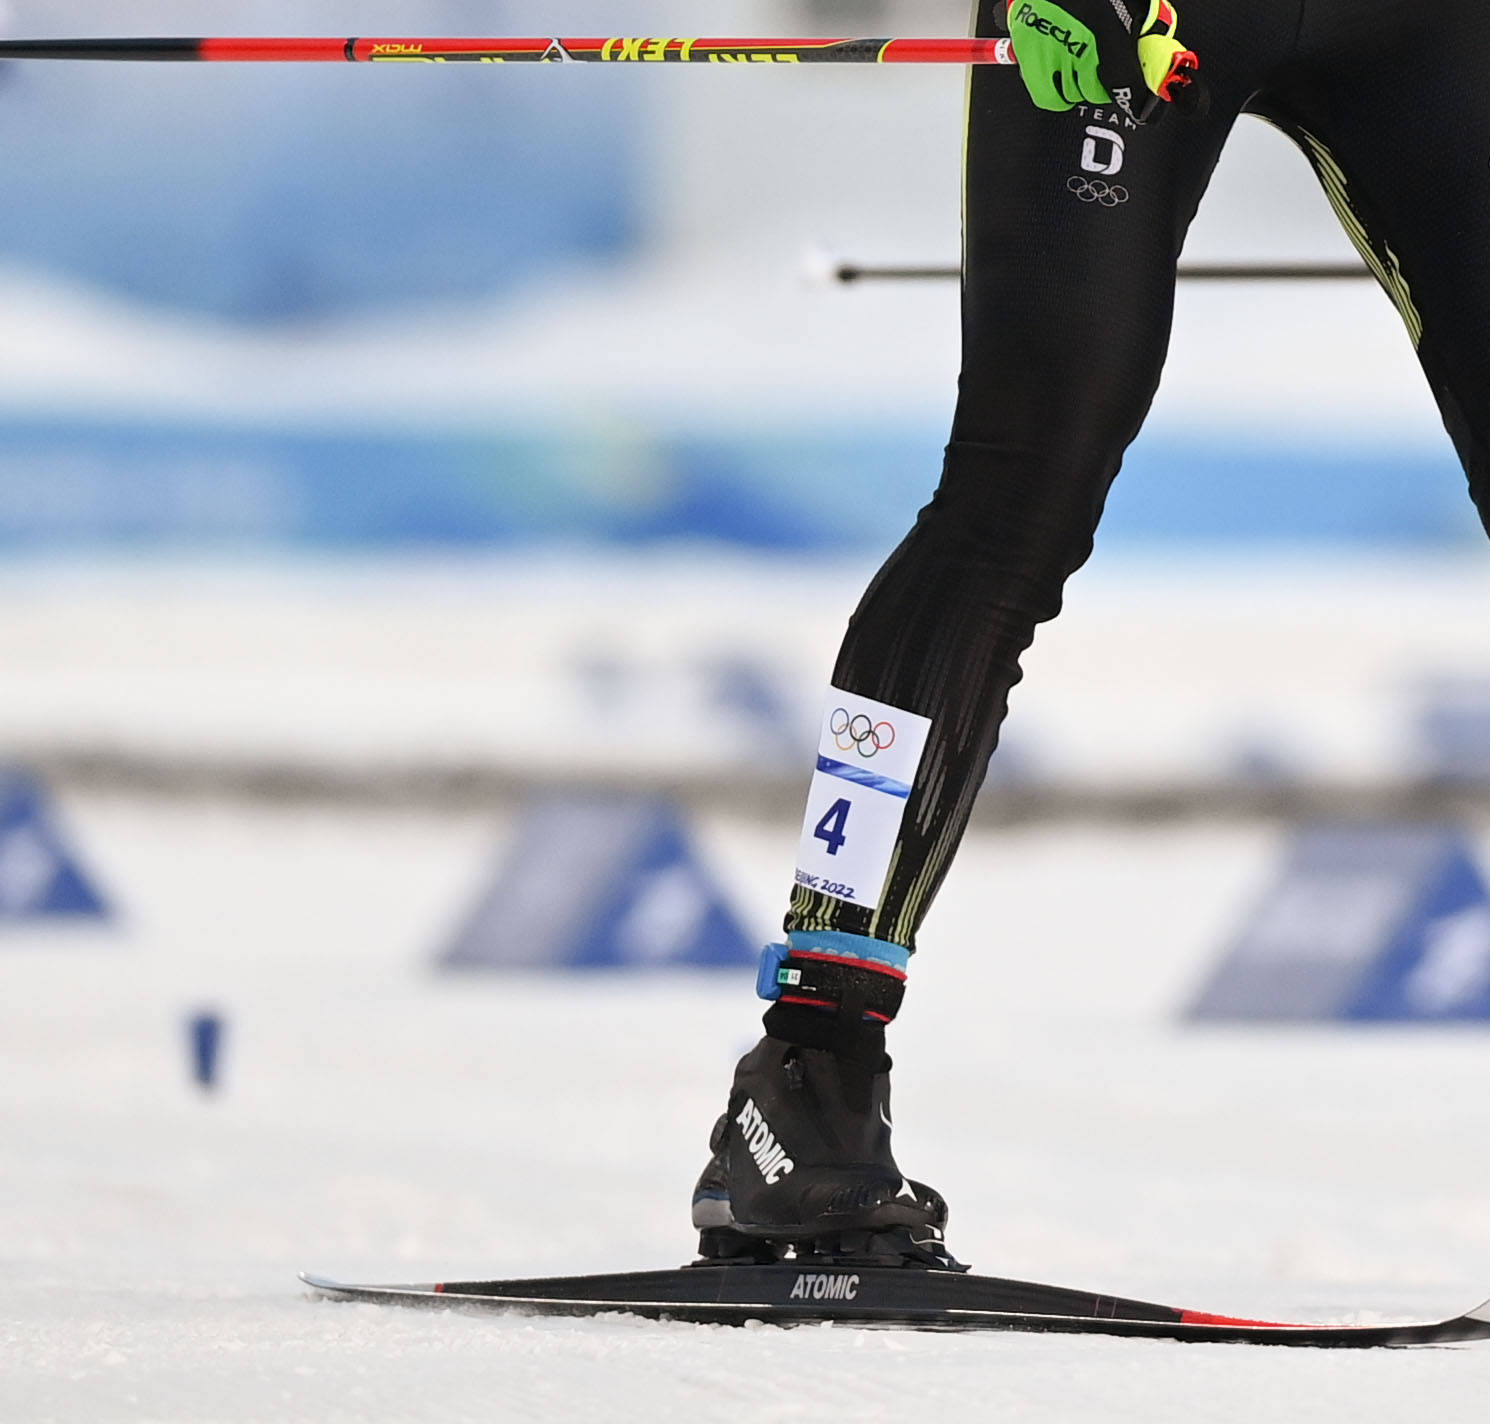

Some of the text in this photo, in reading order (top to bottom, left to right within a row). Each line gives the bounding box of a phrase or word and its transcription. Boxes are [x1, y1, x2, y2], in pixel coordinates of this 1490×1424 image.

[371, 44, 423, 54] max
[600, 37, 698, 62] LEKI
[814, 798, 852, 856] 4
[821, 879, 856, 900] 2022
[736, 1098, 794, 1185] ATOMIC
[790, 1273, 859, 1300] ATOMIC
